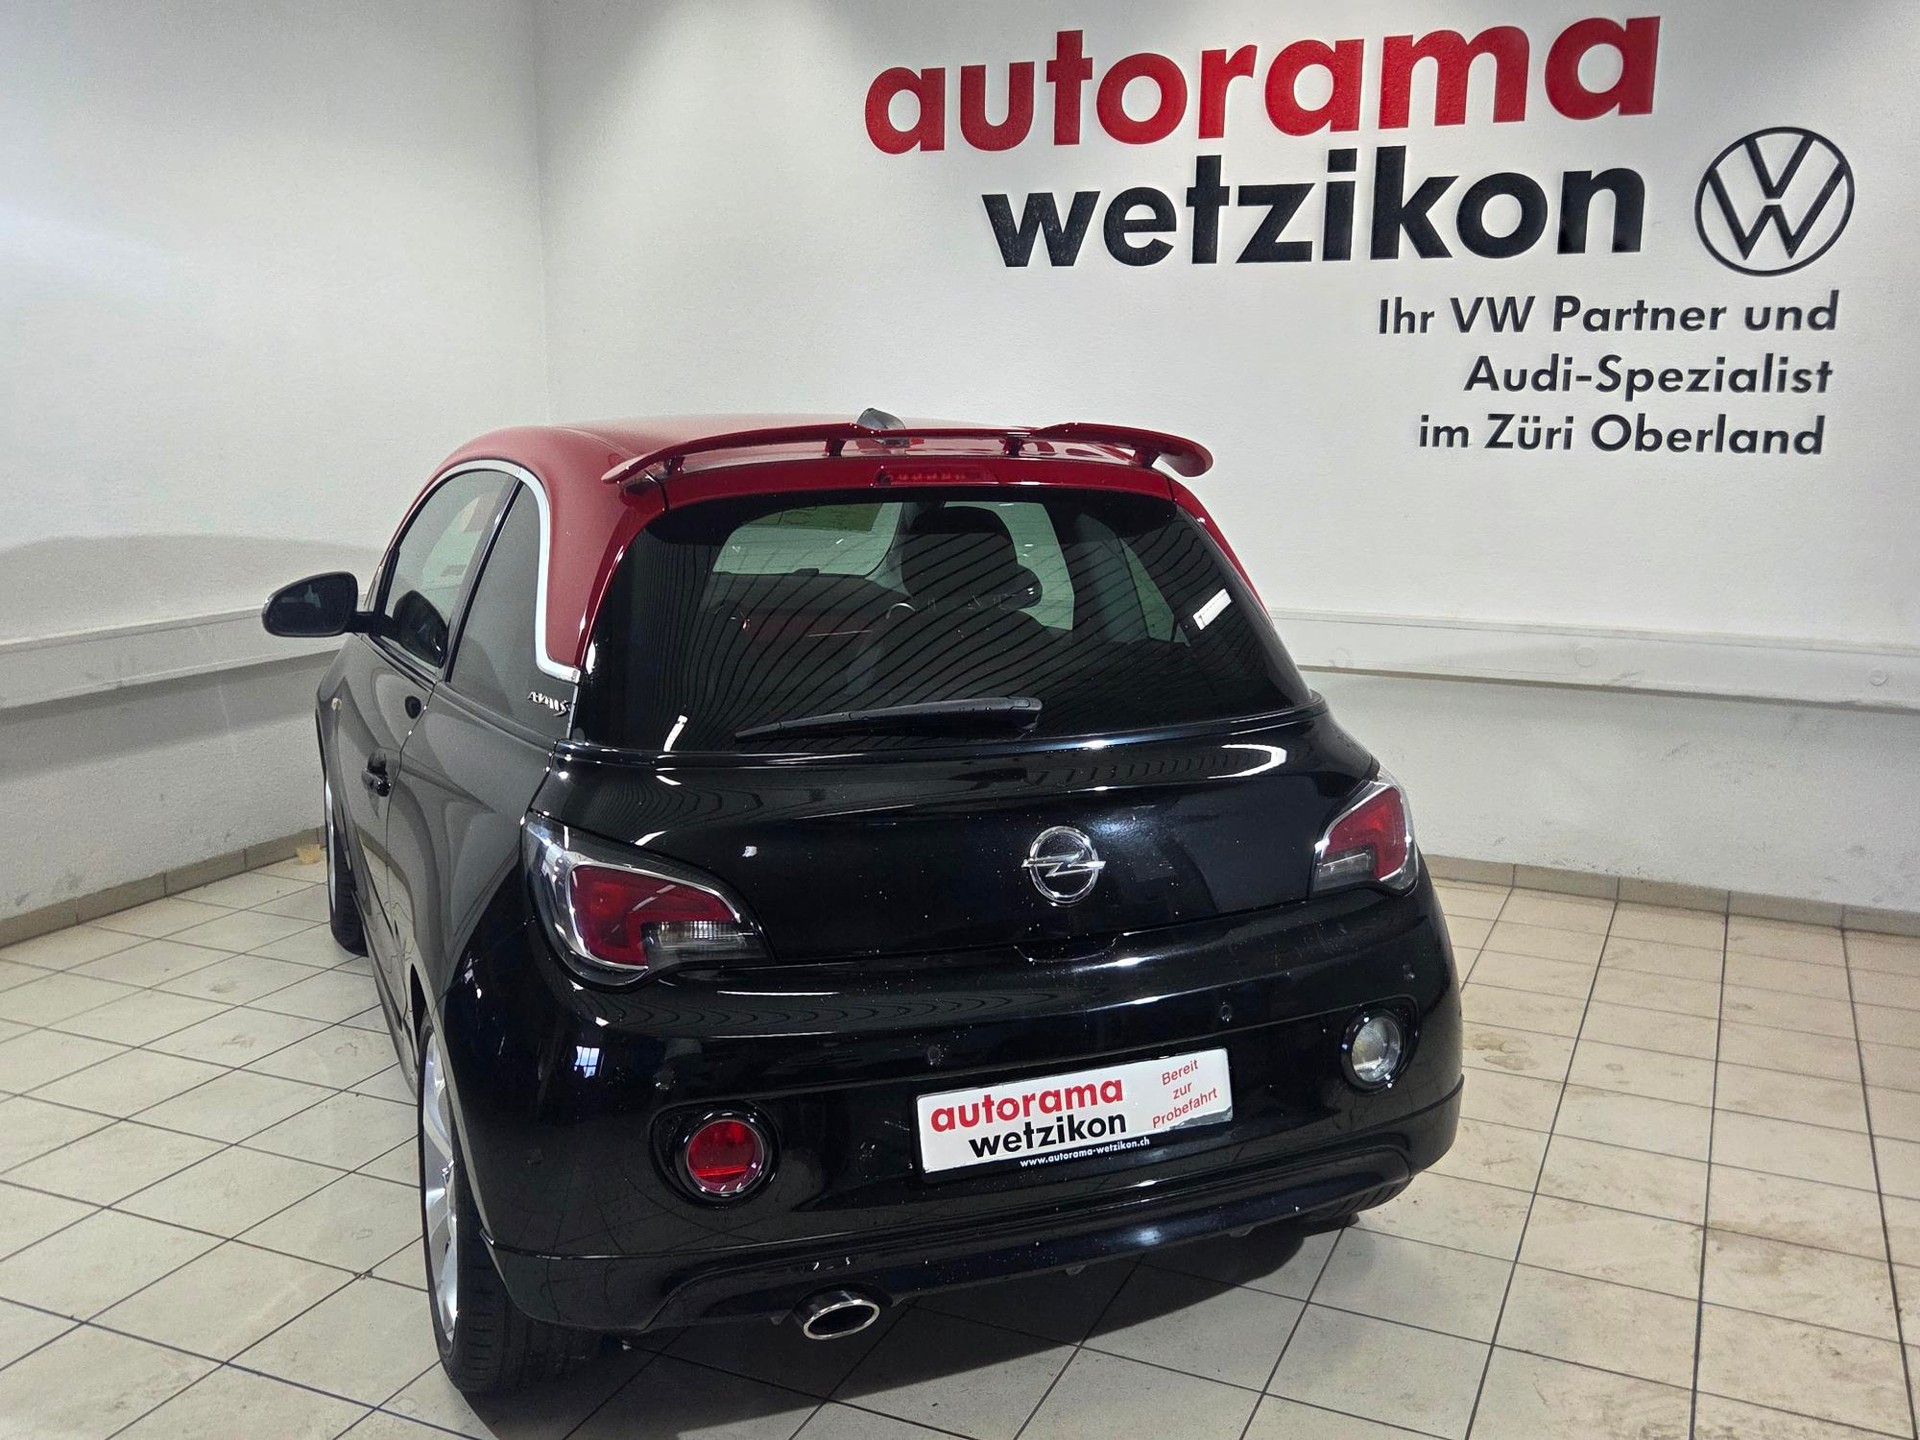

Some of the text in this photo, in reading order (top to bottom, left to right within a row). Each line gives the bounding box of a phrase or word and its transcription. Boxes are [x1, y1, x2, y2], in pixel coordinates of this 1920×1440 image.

[865, 16, 1660, 154] autorama
[982, 146, 1645, 267] wetzikon
[1380, 289, 1840, 335] Ihr VW Partner und
[1463, 352, 1833, 401] Audi-Spezialist
[1419, 412, 1826, 455] im Züri Oberland
[1161, 1059, 1199, 1086] Bereit
[1172, 1080, 1193, 1100] zur
[930, 1078, 1124, 1133] autorama
[1152, 1087, 1218, 1129] Probefahrt
[968, 1112, 1127, 1159] wetzikon
[1019, 1136, 1151, 1168] www.autorama-wetzikon.ch
